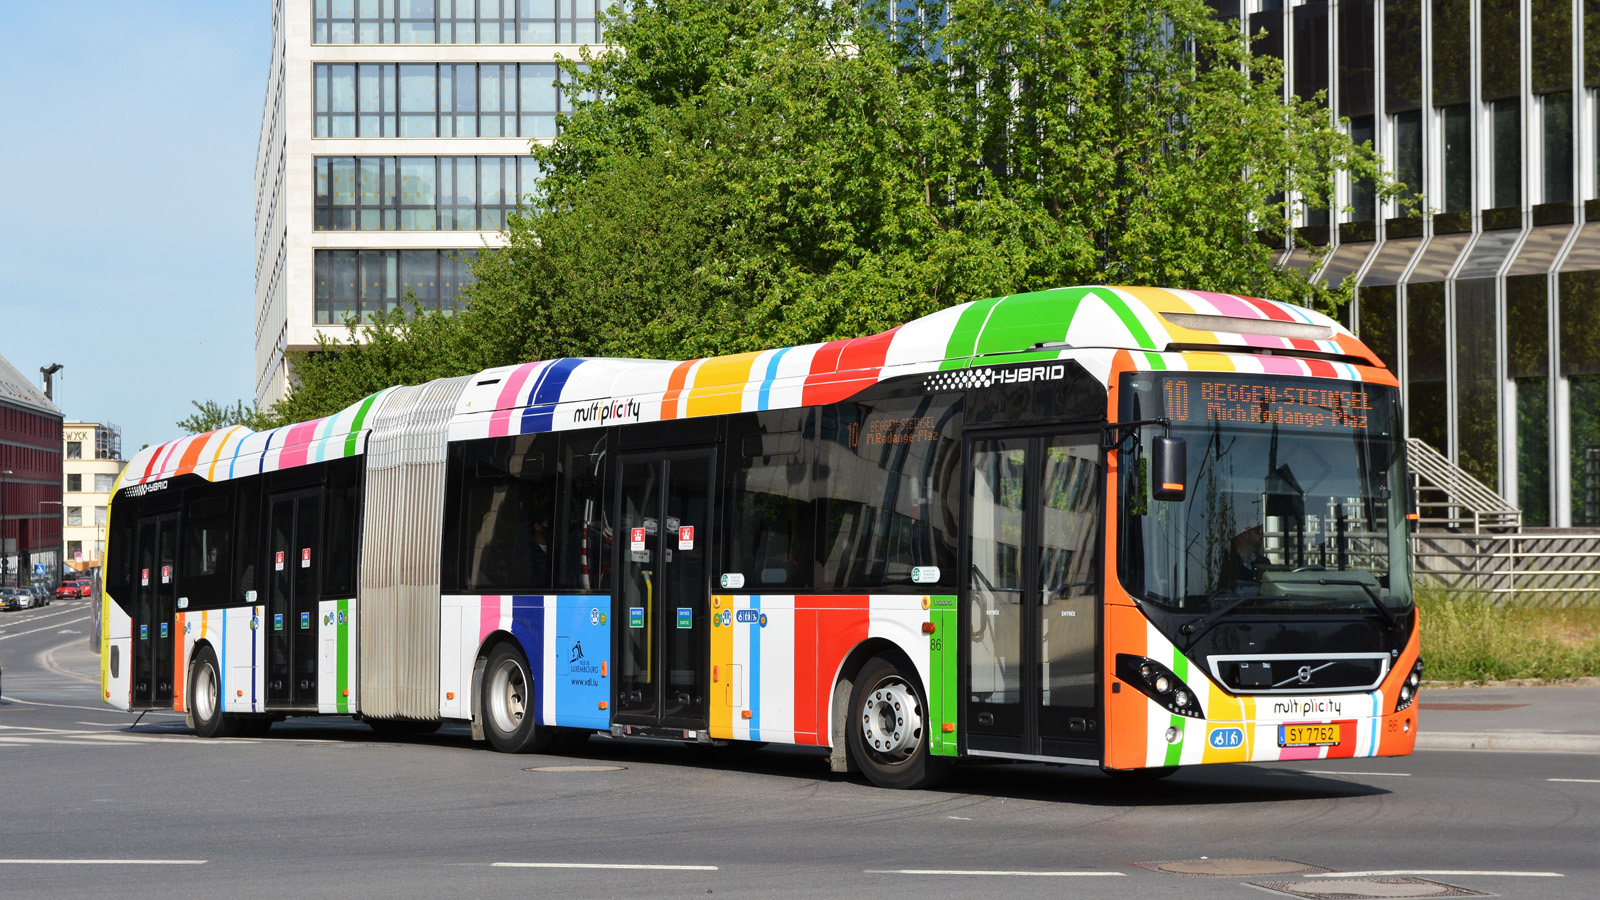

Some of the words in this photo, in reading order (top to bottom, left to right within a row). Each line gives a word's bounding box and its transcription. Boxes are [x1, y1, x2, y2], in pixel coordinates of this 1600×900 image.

[992, 366, 1065, 384] HYBRID
[1164, 380, 1189, 421] 10
[1201, 382, 1373, 410] BEGGEN-STEINSEL
[574, 398, 640, 425] multiplicity
[847, 422, 859, 448] 10
[145, 480, 168, 493] HYBRID
[930, 638, 942, 651] 86
[570, 665, 599, 674] LUXEMBOURG
[571, 678, 599, 687] www.vdl.lu
[1274, 698, 1341, 717] multiplicity
[1388, 719, 1399, 733] 86
[1290, 728, 1303, 742] SY
[1306, 727, 1334, 741] 7762
